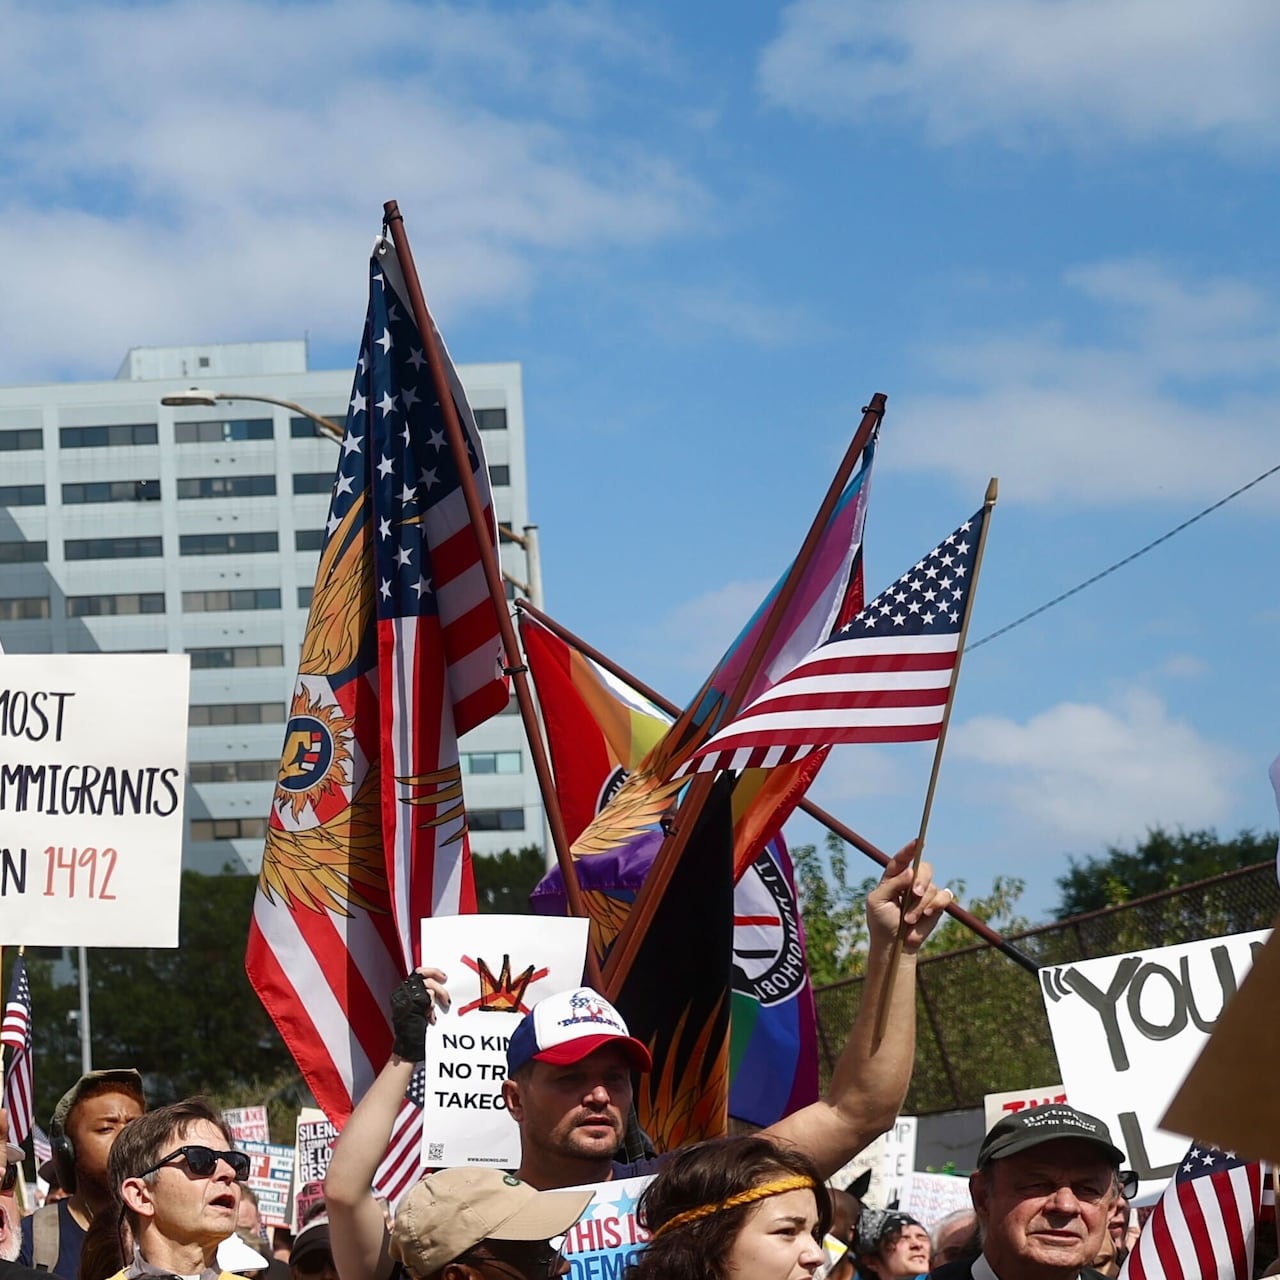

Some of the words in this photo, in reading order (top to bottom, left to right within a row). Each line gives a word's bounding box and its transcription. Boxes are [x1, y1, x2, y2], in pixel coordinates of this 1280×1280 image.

[42, 845, 119, 900] 1492
[442, 1034, 476, 1050] NO
[438, 1062, 473, 1079] NO
[434, 1091, 508, 1111] TAKEO
